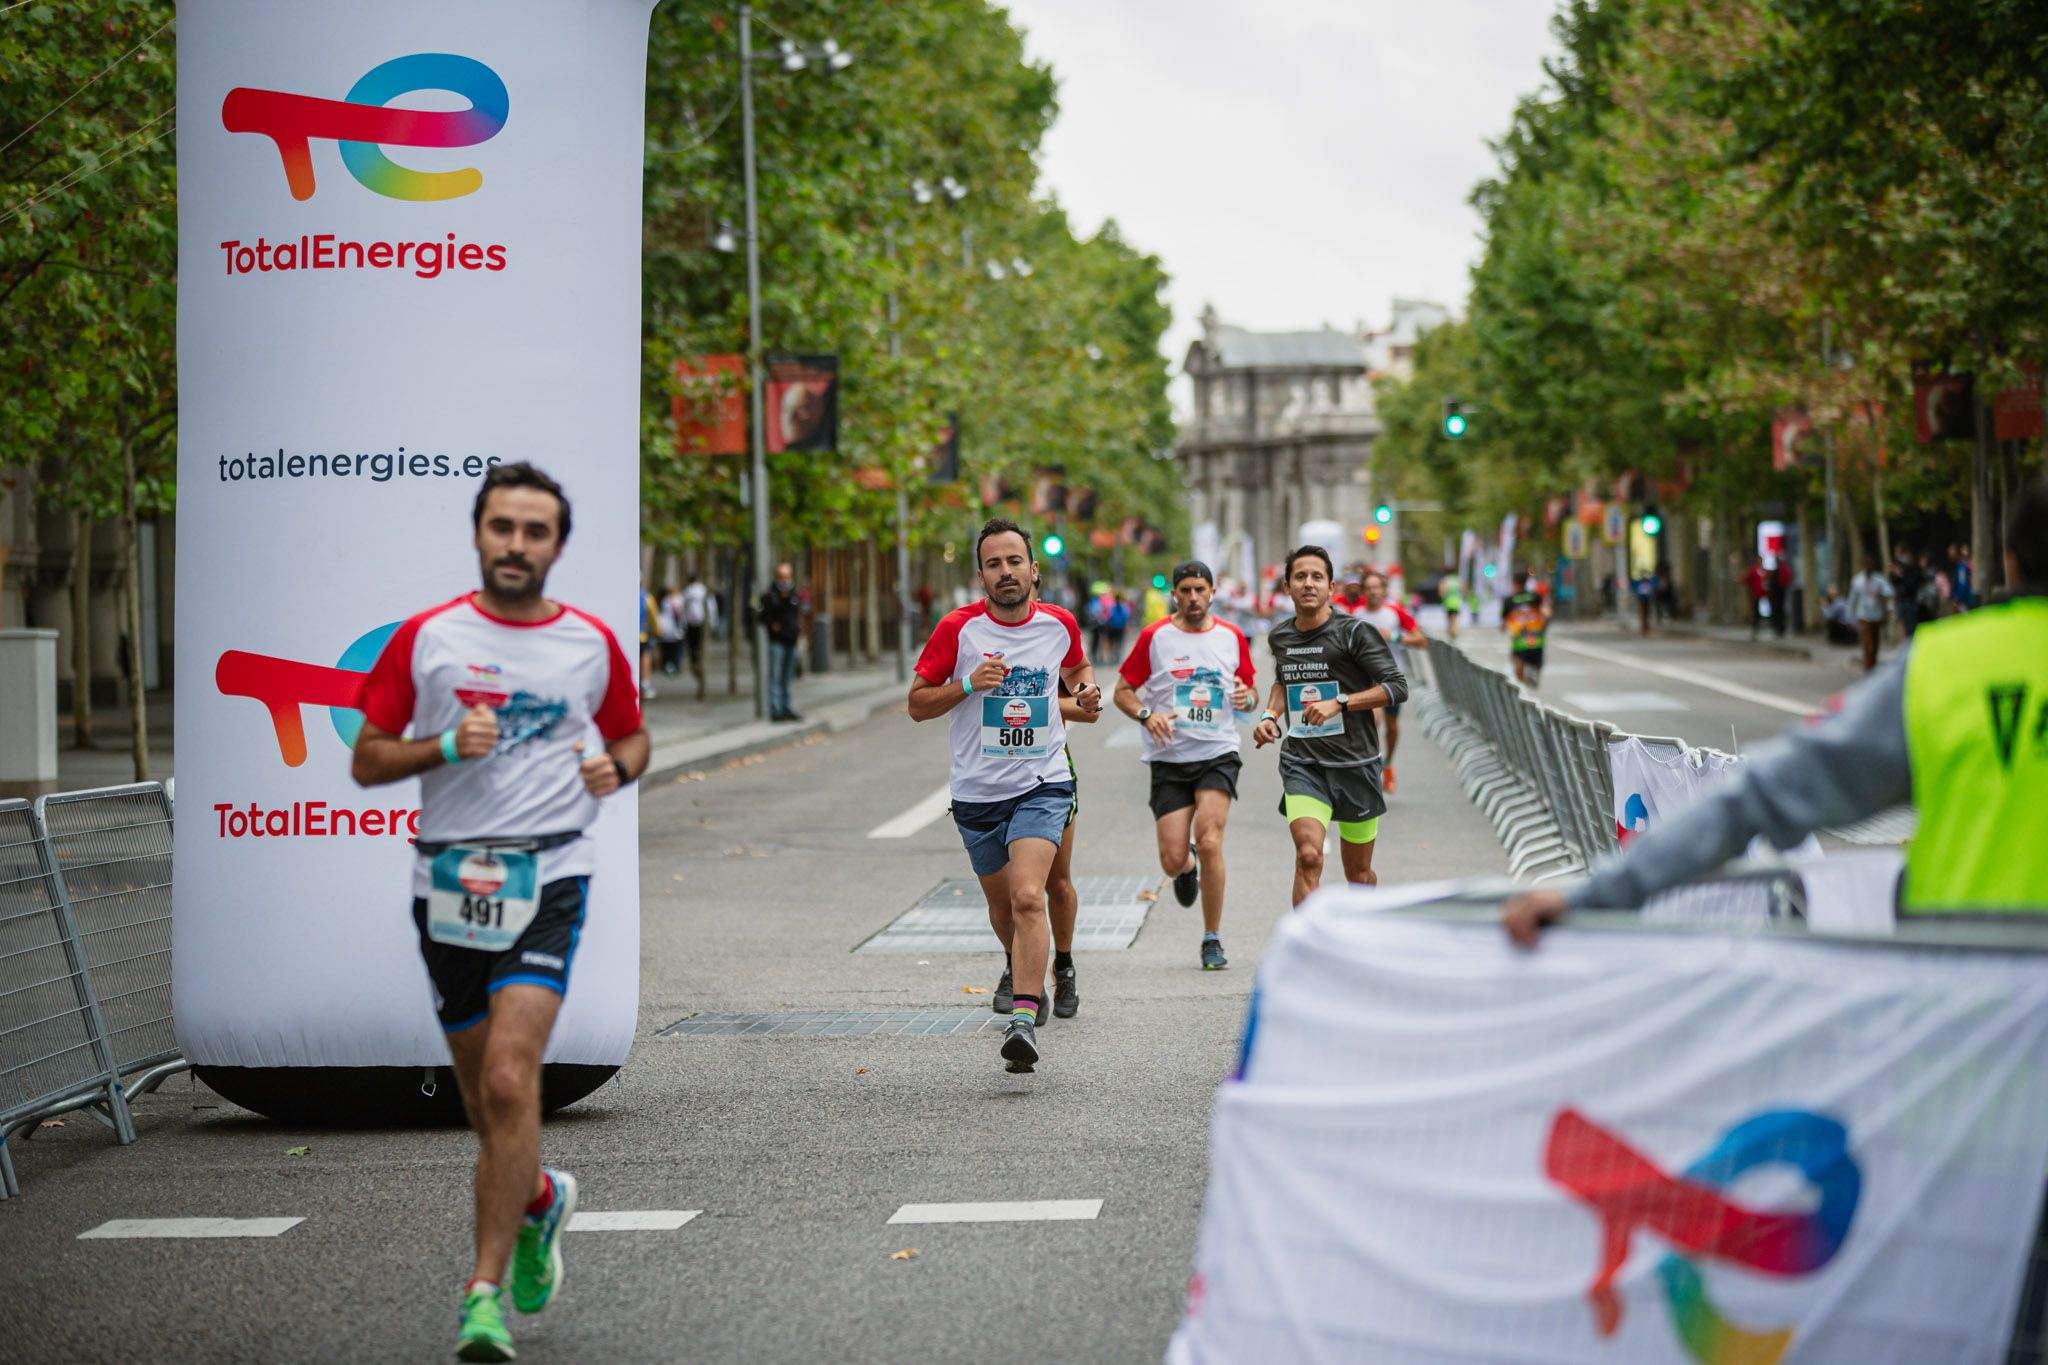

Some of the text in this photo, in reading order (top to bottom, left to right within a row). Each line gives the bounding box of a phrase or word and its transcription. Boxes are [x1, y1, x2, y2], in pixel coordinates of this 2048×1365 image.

[220, 233, 507, 279] TotalEnergies
[1298, 662, 1329, 671] CARRERA
[1292, 672, 1301, 680] LA
[1302, 671, 1329, 680] CIENCIA
[1187, 708, 1212, 723] 489
[999, 728, 1034, 747] 508
[460, 894, 503, 929] 491
